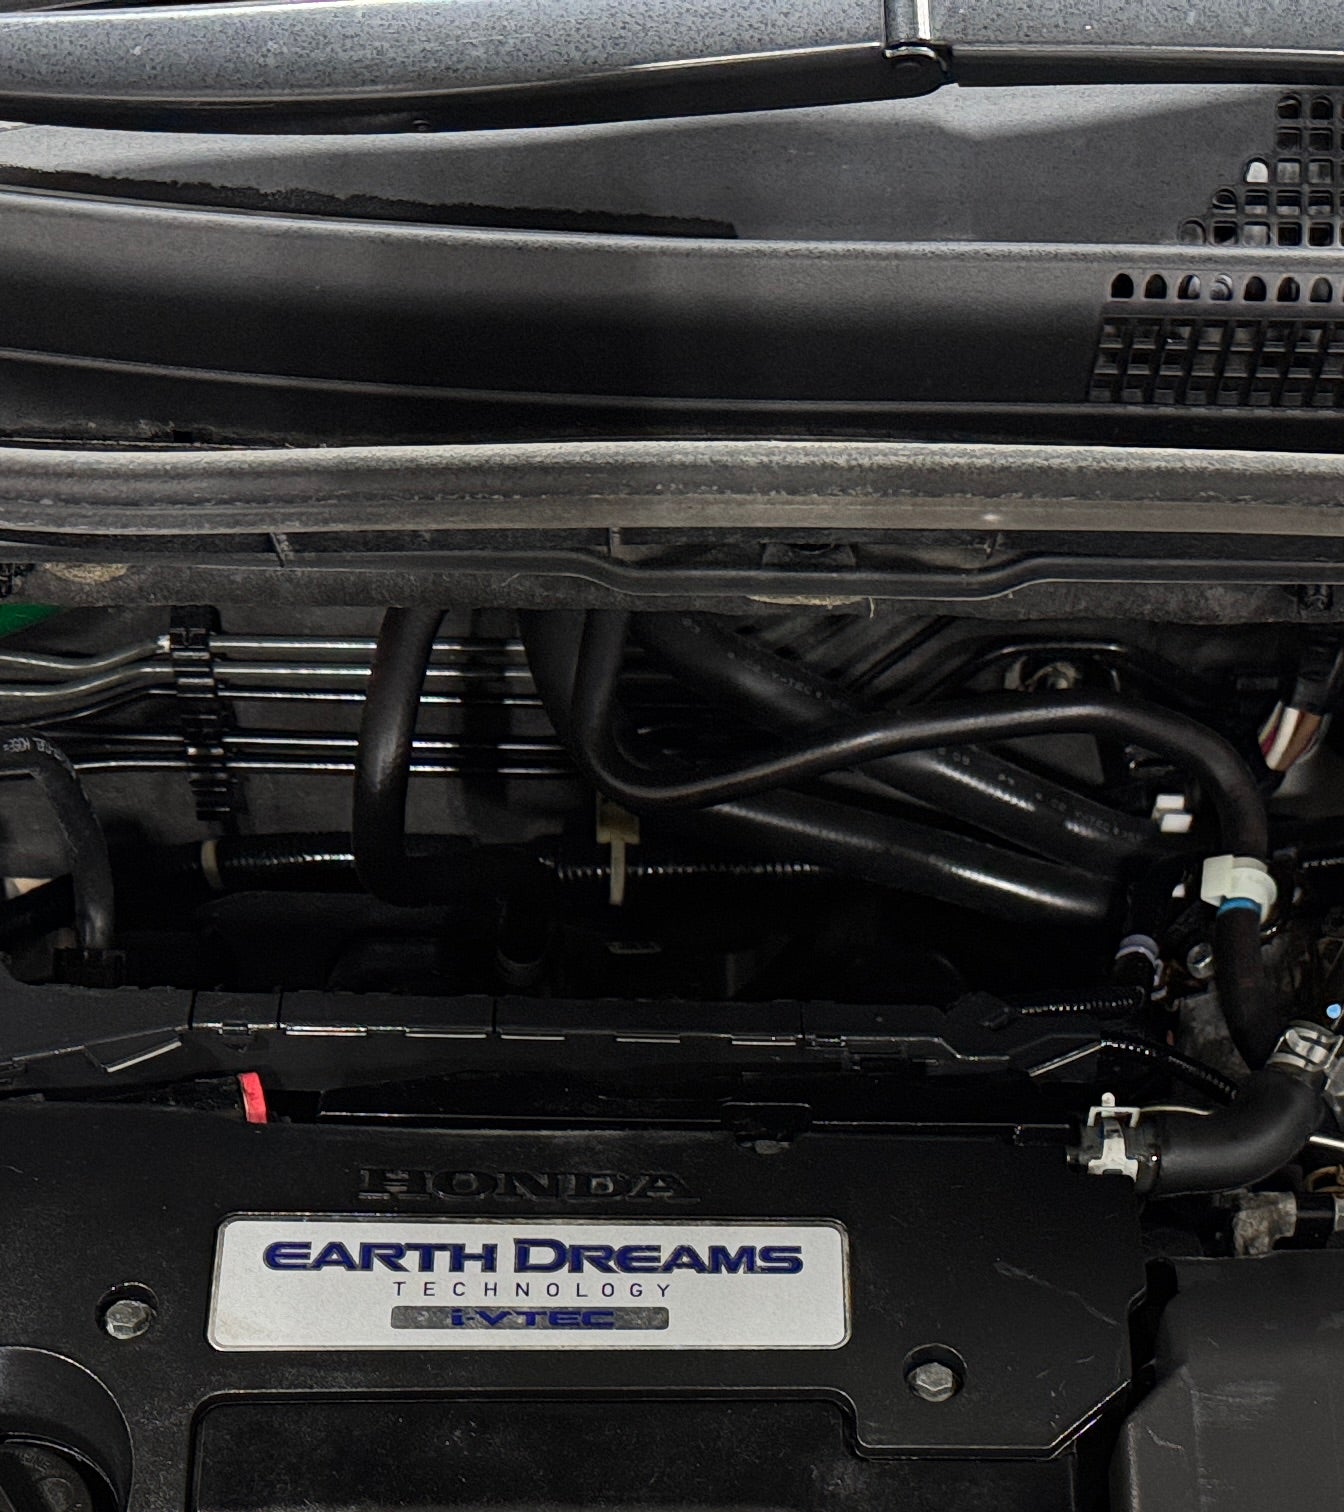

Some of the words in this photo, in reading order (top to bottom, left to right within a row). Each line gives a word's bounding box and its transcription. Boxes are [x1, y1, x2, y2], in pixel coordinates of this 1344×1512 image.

[357, 1165, 702, 1203] HONDA
[262, 1240, 498, 1275] EARTH
[514, 1237, 804, 1275] DREAMS
[394, 1281, 674, 1299] TECHNOLOGY
[450, 1310, 617, 1330] i-VTEC
